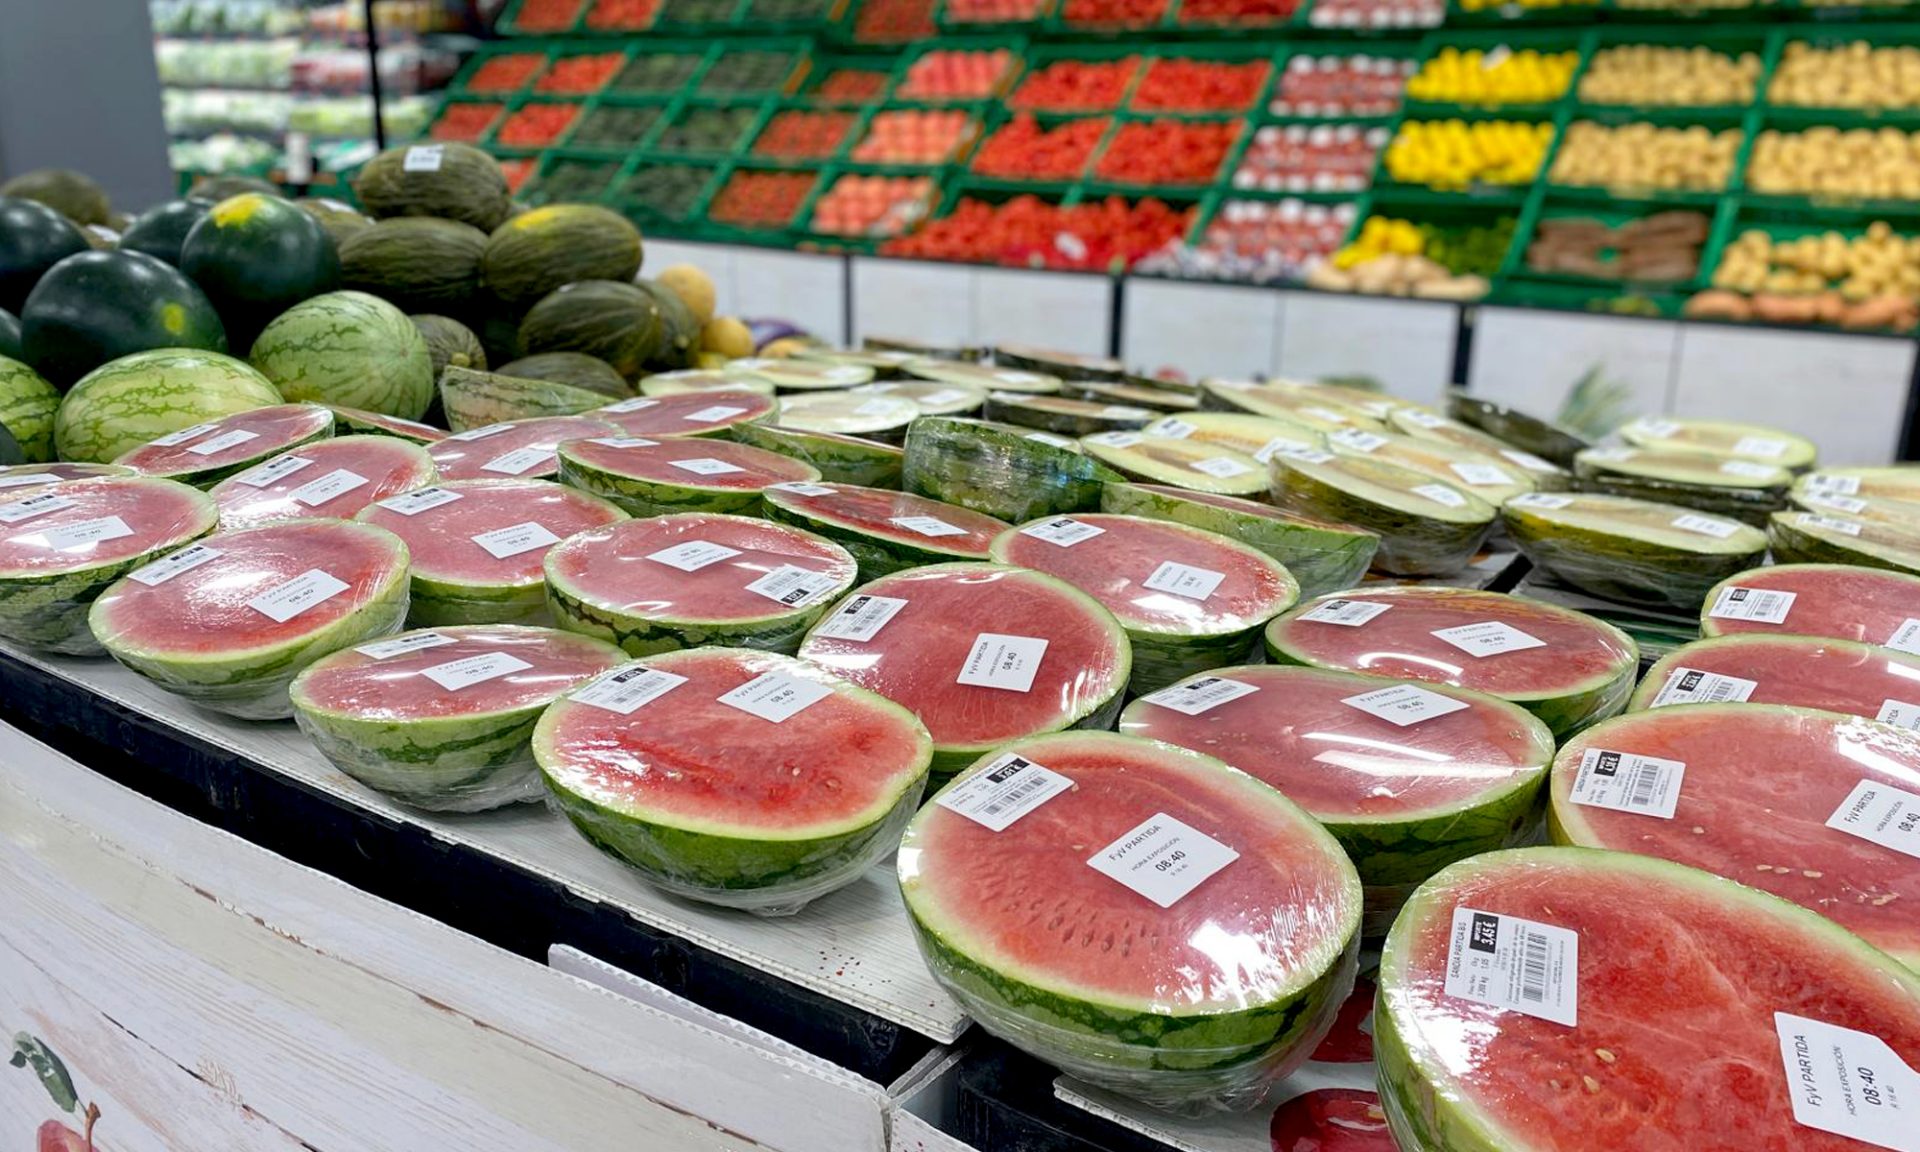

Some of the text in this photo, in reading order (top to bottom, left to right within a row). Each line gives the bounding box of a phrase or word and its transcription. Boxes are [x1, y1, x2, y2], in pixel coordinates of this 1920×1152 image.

[1000, 651, 1017, 670] 08:40
[1107, 823, 1163, 861] FyV PARTIDA
[1152, 849, 1188, 872] 08:40
[1792, 1032, 1823, 1107] FyV PARTIDA
[1856, 1065, 1882, 1106] 08:40
[1842, 1091, 1857, 1116] HORA
